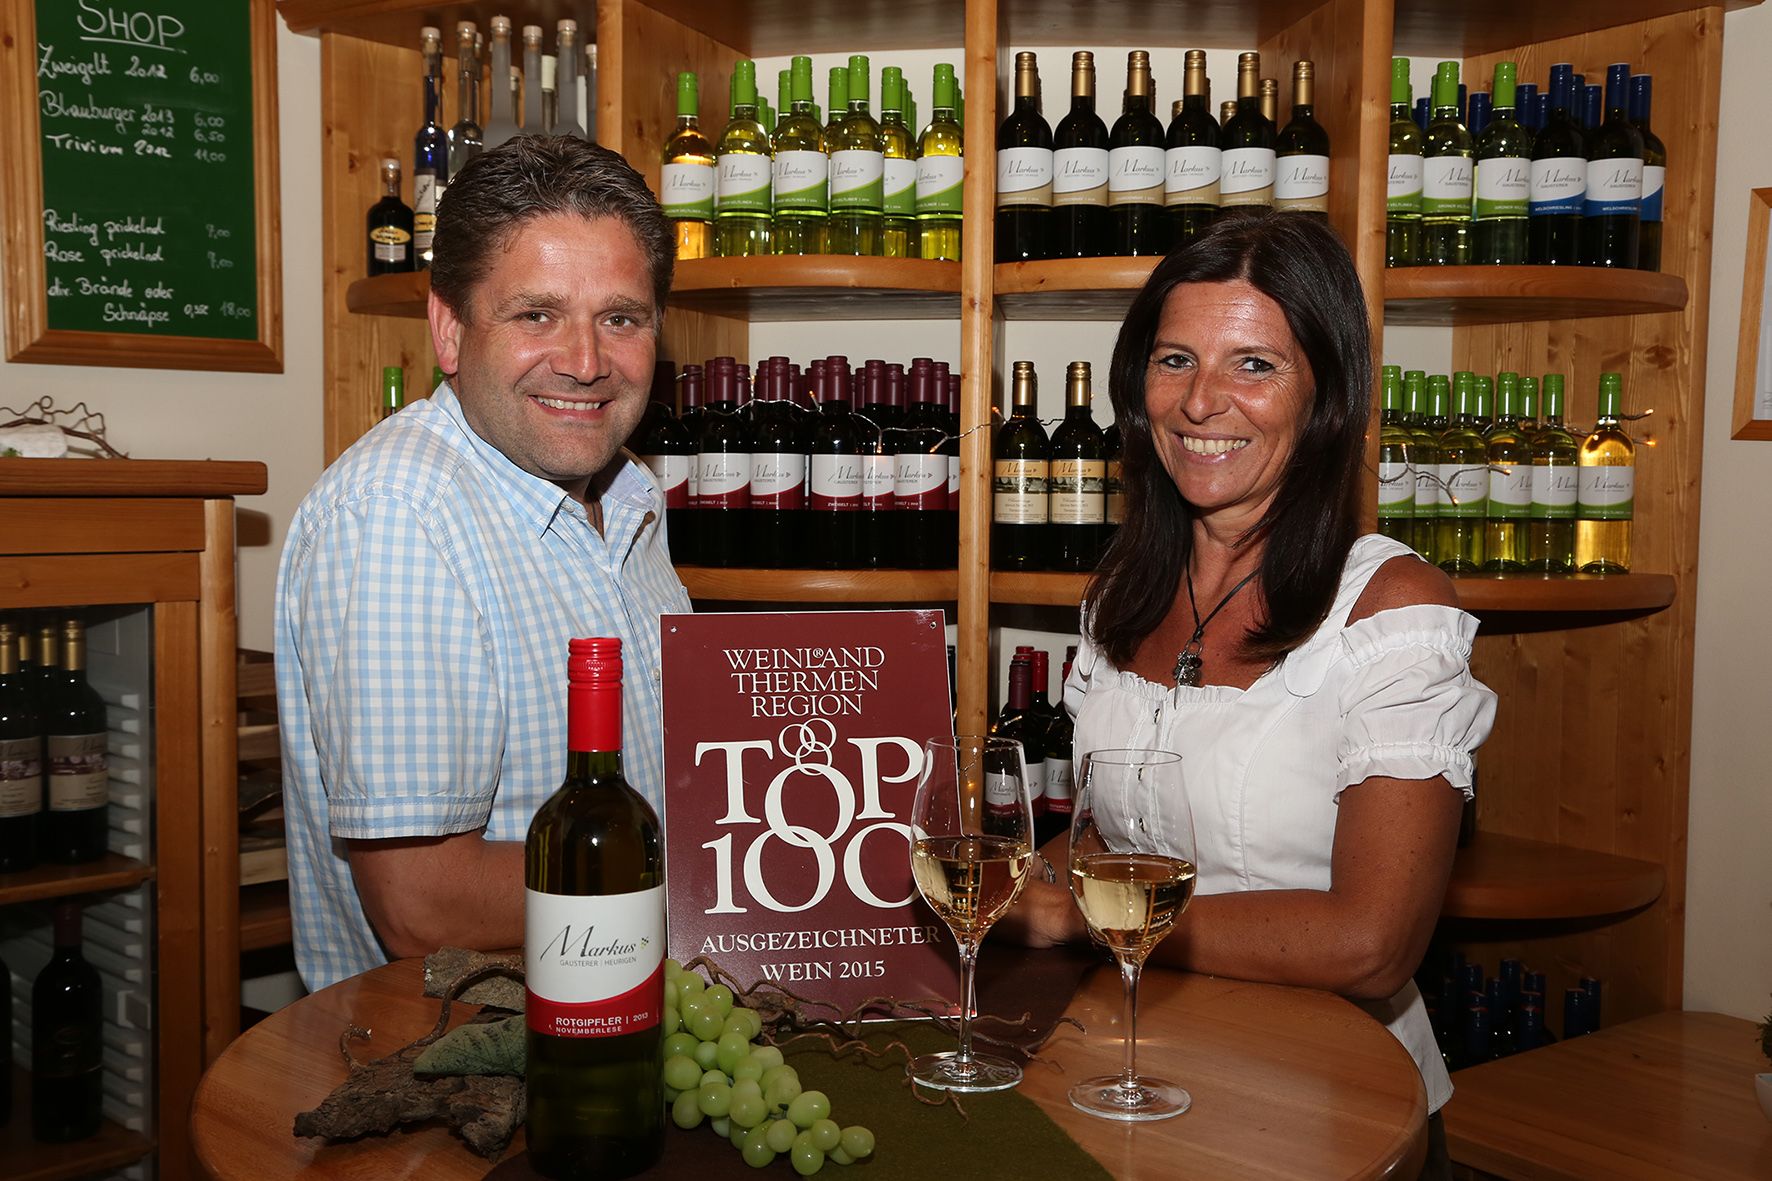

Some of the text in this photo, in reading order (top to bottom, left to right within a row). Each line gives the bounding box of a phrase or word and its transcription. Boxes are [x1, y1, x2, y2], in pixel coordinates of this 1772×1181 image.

[77, 0, 184, 46] SHOP
[37, 43, 220, 85] Zweigelt 2012 6,00
[39, 90, 136, 134] Blauburger
[141, 104, 175, 123] 2013
[141, 124, 226, 143] 2012 6,50
[45, 133, 226, 163] Trivium 2012 11,00
[42, 209, 100, 246] Riesling
[43, 240, 86, 262] Rose
[75, 276, 133, 298] Brände
[144, 281, 175, 299] oder
[102, 302, 170, 328] Schnäpse
[730, 670, 879, 695] THERMEN
[751, 694, 862, 718] REGION
[695, 735, 934, 847] TOP
[701, 822, 928, 915] 100
[540, 924, 636, 961] Markus
[700, 925, 942, 955] AUSGEZEICHNETER
[559, 957, 637, 967] GAUSTERER HEURIGEN
[760, 960, 886, 982] WEIN 2015
[555, 1011, 649, 1027] ROTGIPFLER 2013
[555, 1026, 622, 1035] NOVEMBERLESE
